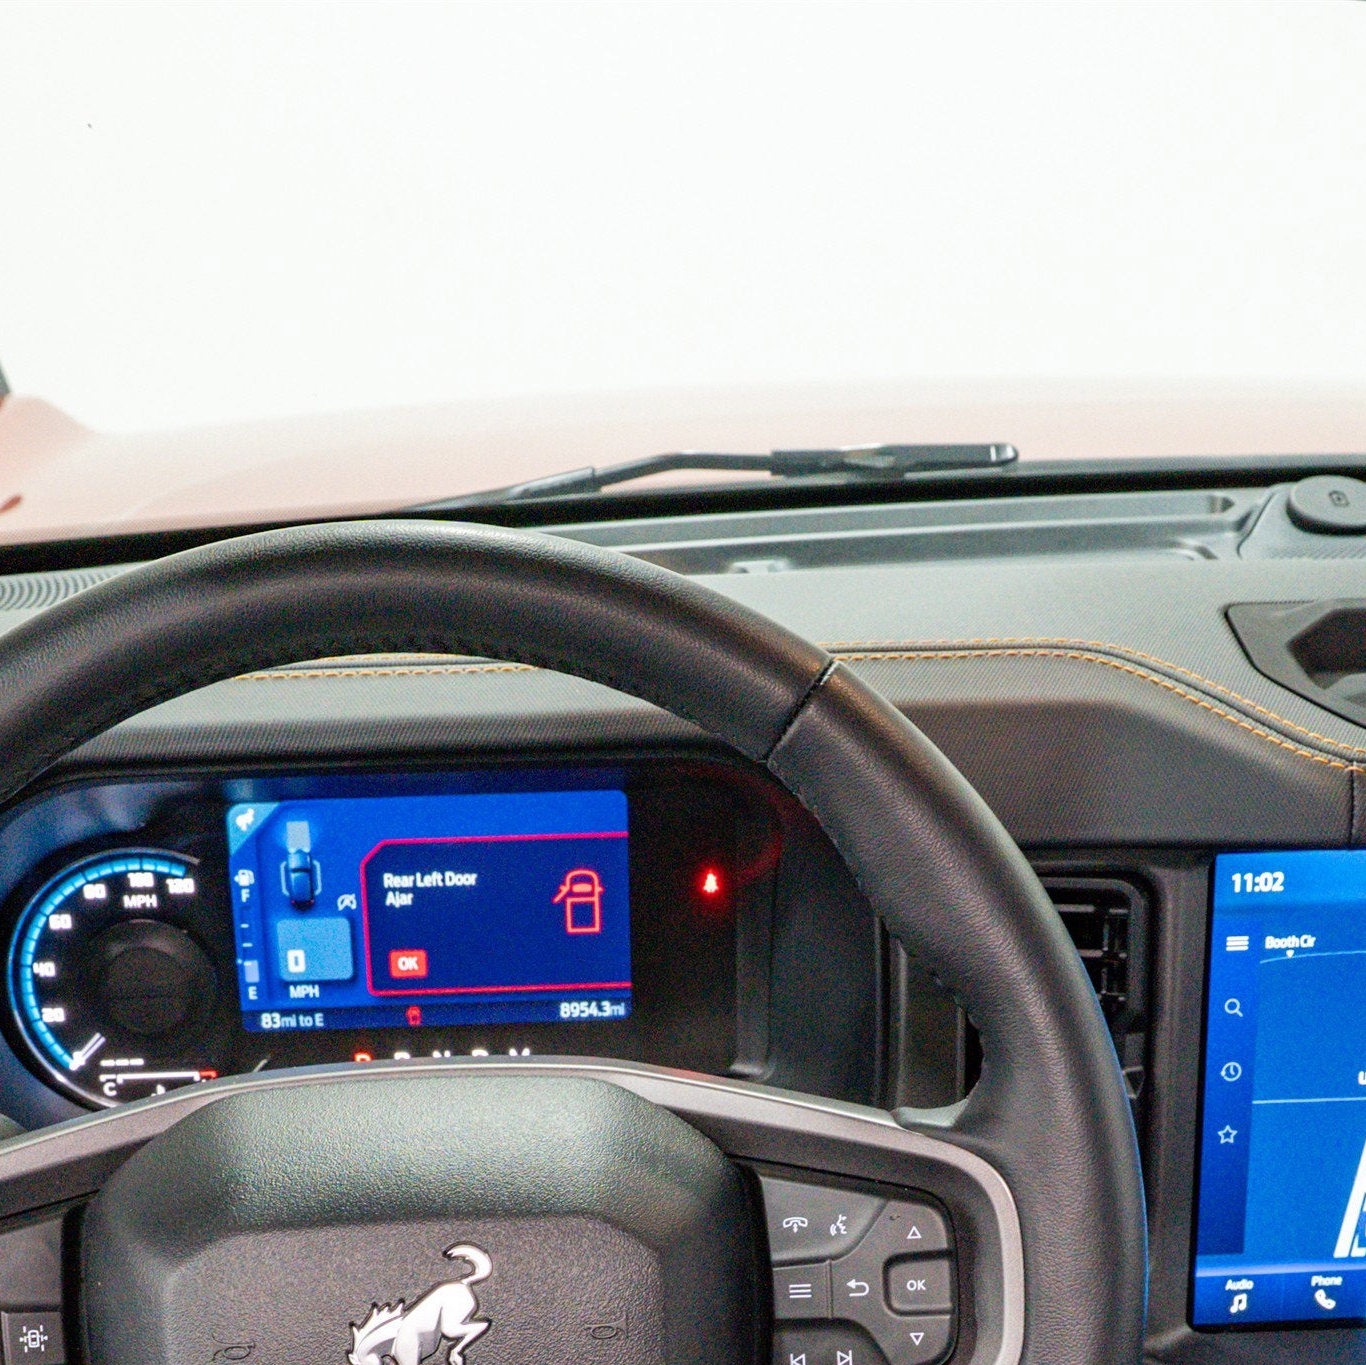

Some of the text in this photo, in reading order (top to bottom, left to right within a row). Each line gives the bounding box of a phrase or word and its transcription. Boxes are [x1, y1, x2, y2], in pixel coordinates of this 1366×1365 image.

[383, 871, 477, 889] Rear Left Door
[1231, 871, 1285, 893] 11:02
[123, 895, 158, 909] MPH
[241, 889, 250, 903] F
[385, 891, 414, 908] Ajar
[398, 958, 418, 971] OK
[248, 986, 258, 1000] E
[290, 985, 319, 999] MPH
[299, 1015, 314, 1028] to
[315, 1013, 324, 1027] E
[906, 1279, 927, 1292] OK
[1225, 1279, 1254, 1291] Audio
[1311, 1275, 1343, 1287] Phone
